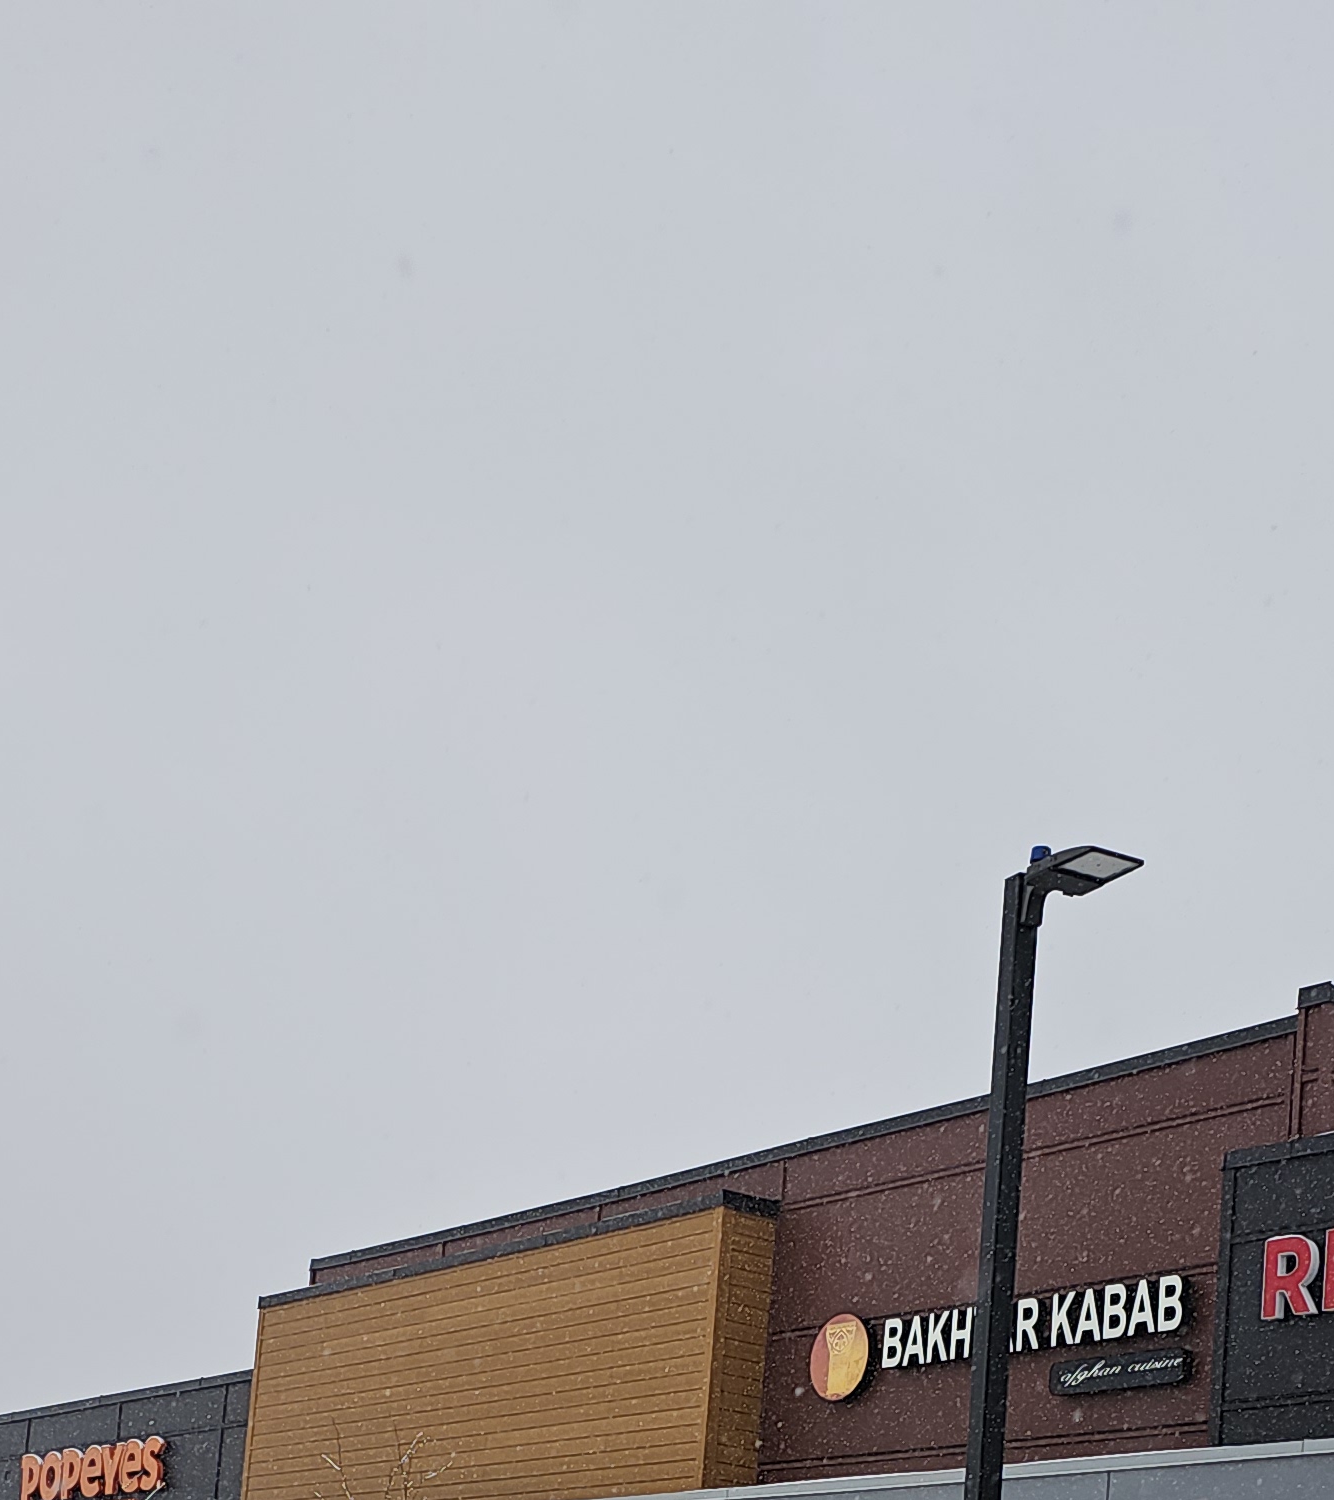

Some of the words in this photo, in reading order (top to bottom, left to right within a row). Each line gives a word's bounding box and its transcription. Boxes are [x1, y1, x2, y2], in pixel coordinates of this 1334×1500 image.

[881, 1298, 1039, 1369] BAKHR
[1051, 1275, 1183, 1347] KABAB
[1059, 1360, 1121, 1387] afghan
[1127, 1357, 1183, 1373] cuisine
